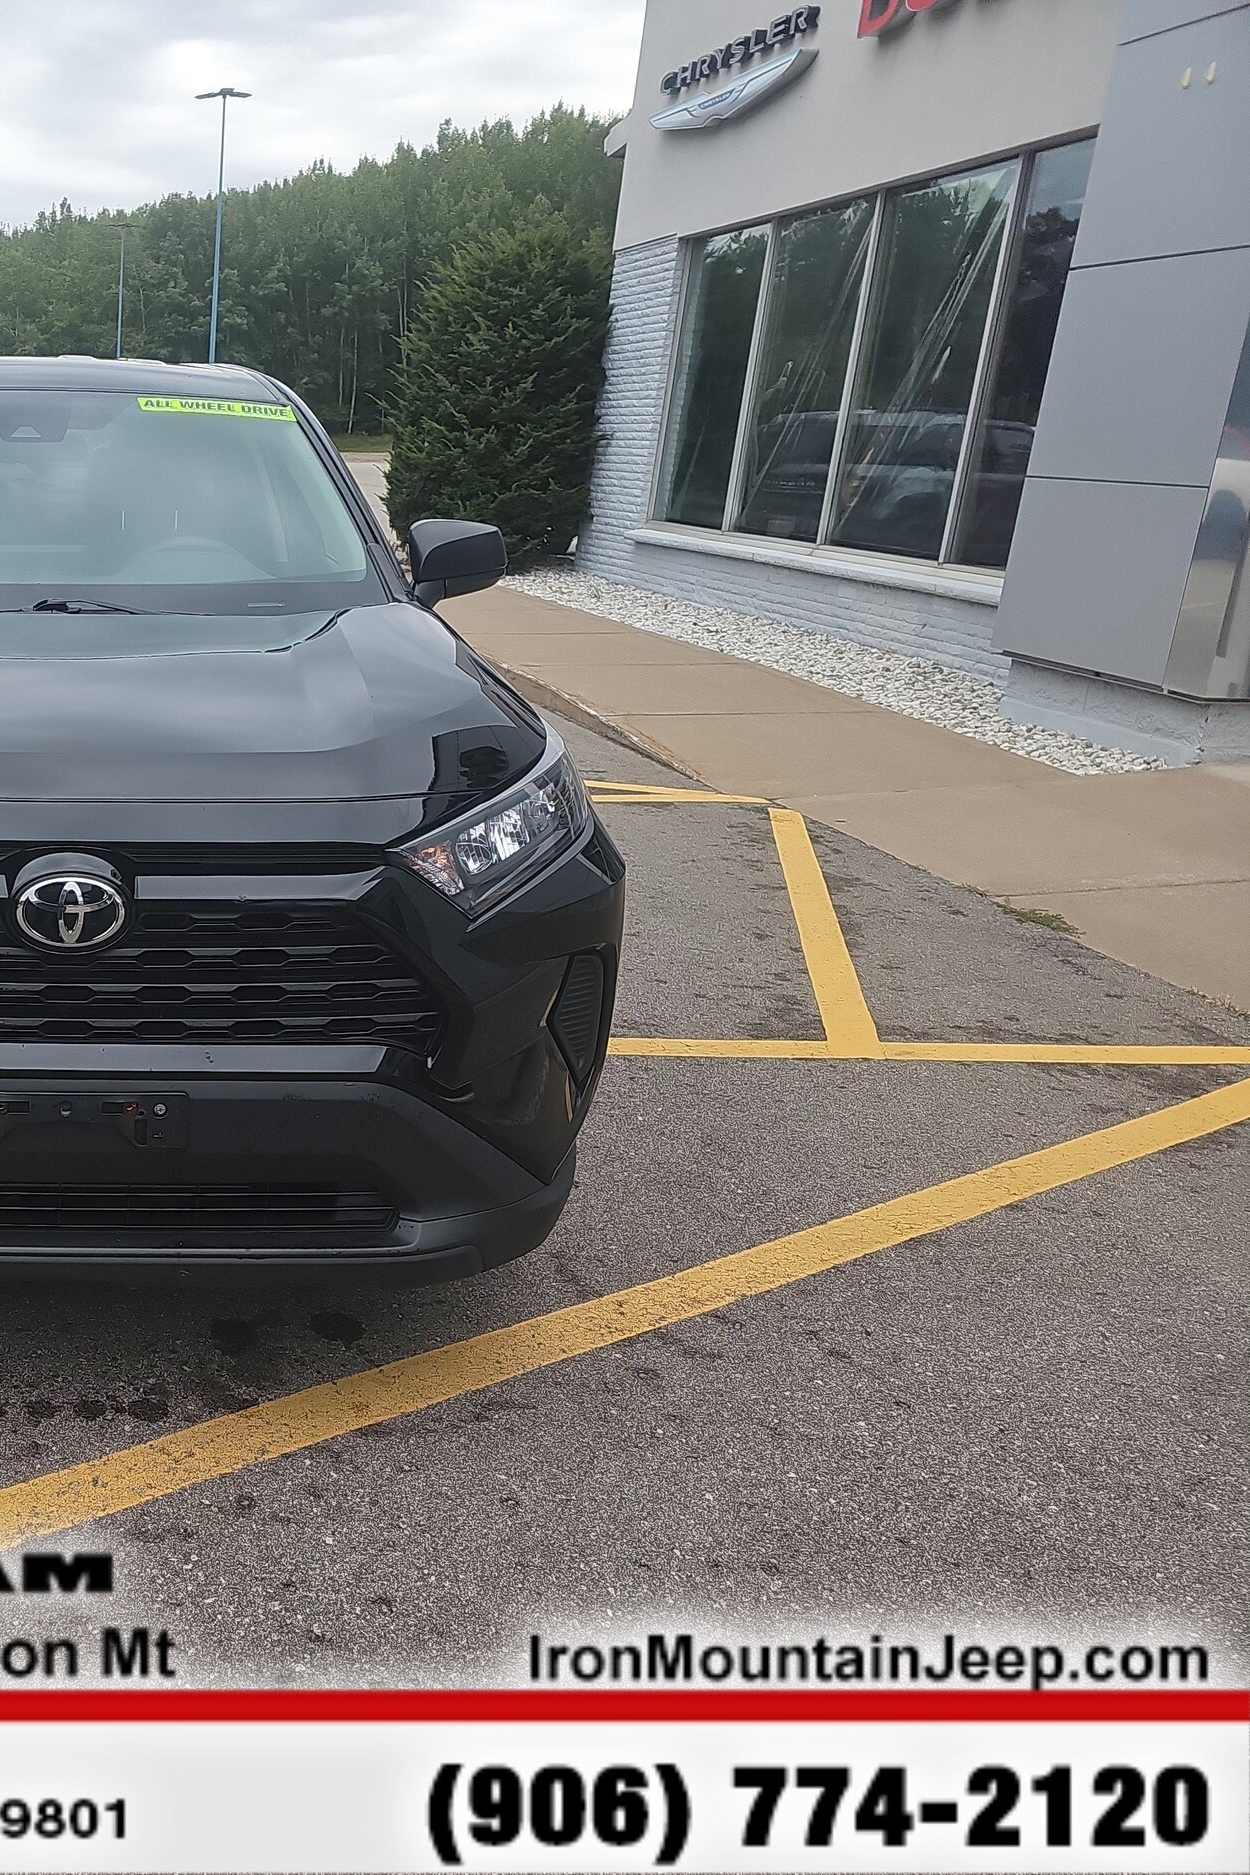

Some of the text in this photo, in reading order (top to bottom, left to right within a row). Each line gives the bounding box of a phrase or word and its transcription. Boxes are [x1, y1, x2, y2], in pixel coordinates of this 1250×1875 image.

[659, 4, 821, 96] CHRYSLER
[143, 398, 291, 418] ALL WHEEL DRIVE
